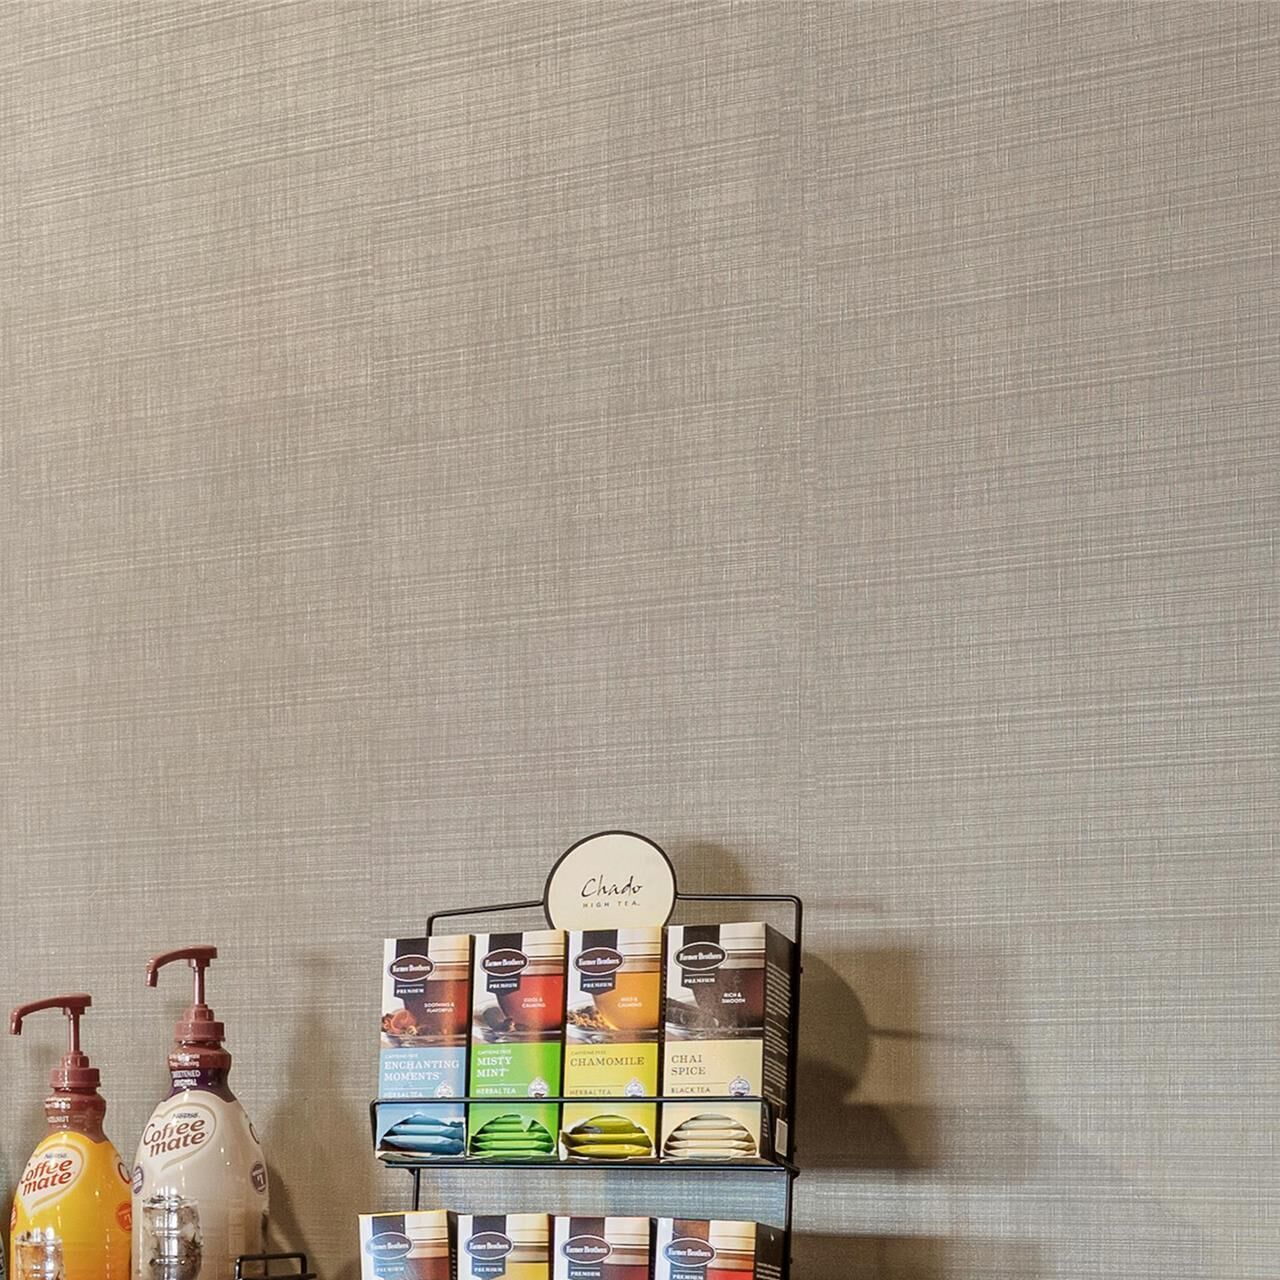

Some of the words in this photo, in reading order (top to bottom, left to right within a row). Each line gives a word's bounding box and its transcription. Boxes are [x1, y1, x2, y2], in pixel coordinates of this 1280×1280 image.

[581, 874, 644, 898] Chado
[476, 1056, 512, 1066] MISTY
[570, 1057, 645, 1067] CHAMOMILE
[671, 1054, 702, 1064] CHAI
[384, 1060, 459, 1070] ENCHANTING
[671, 1066, 706, 1076] SPICE
[150, 1132, 206, 1158] mate
[21, 1160, 73, 1184] offee
[22, 1172, 73, 1197] mate
